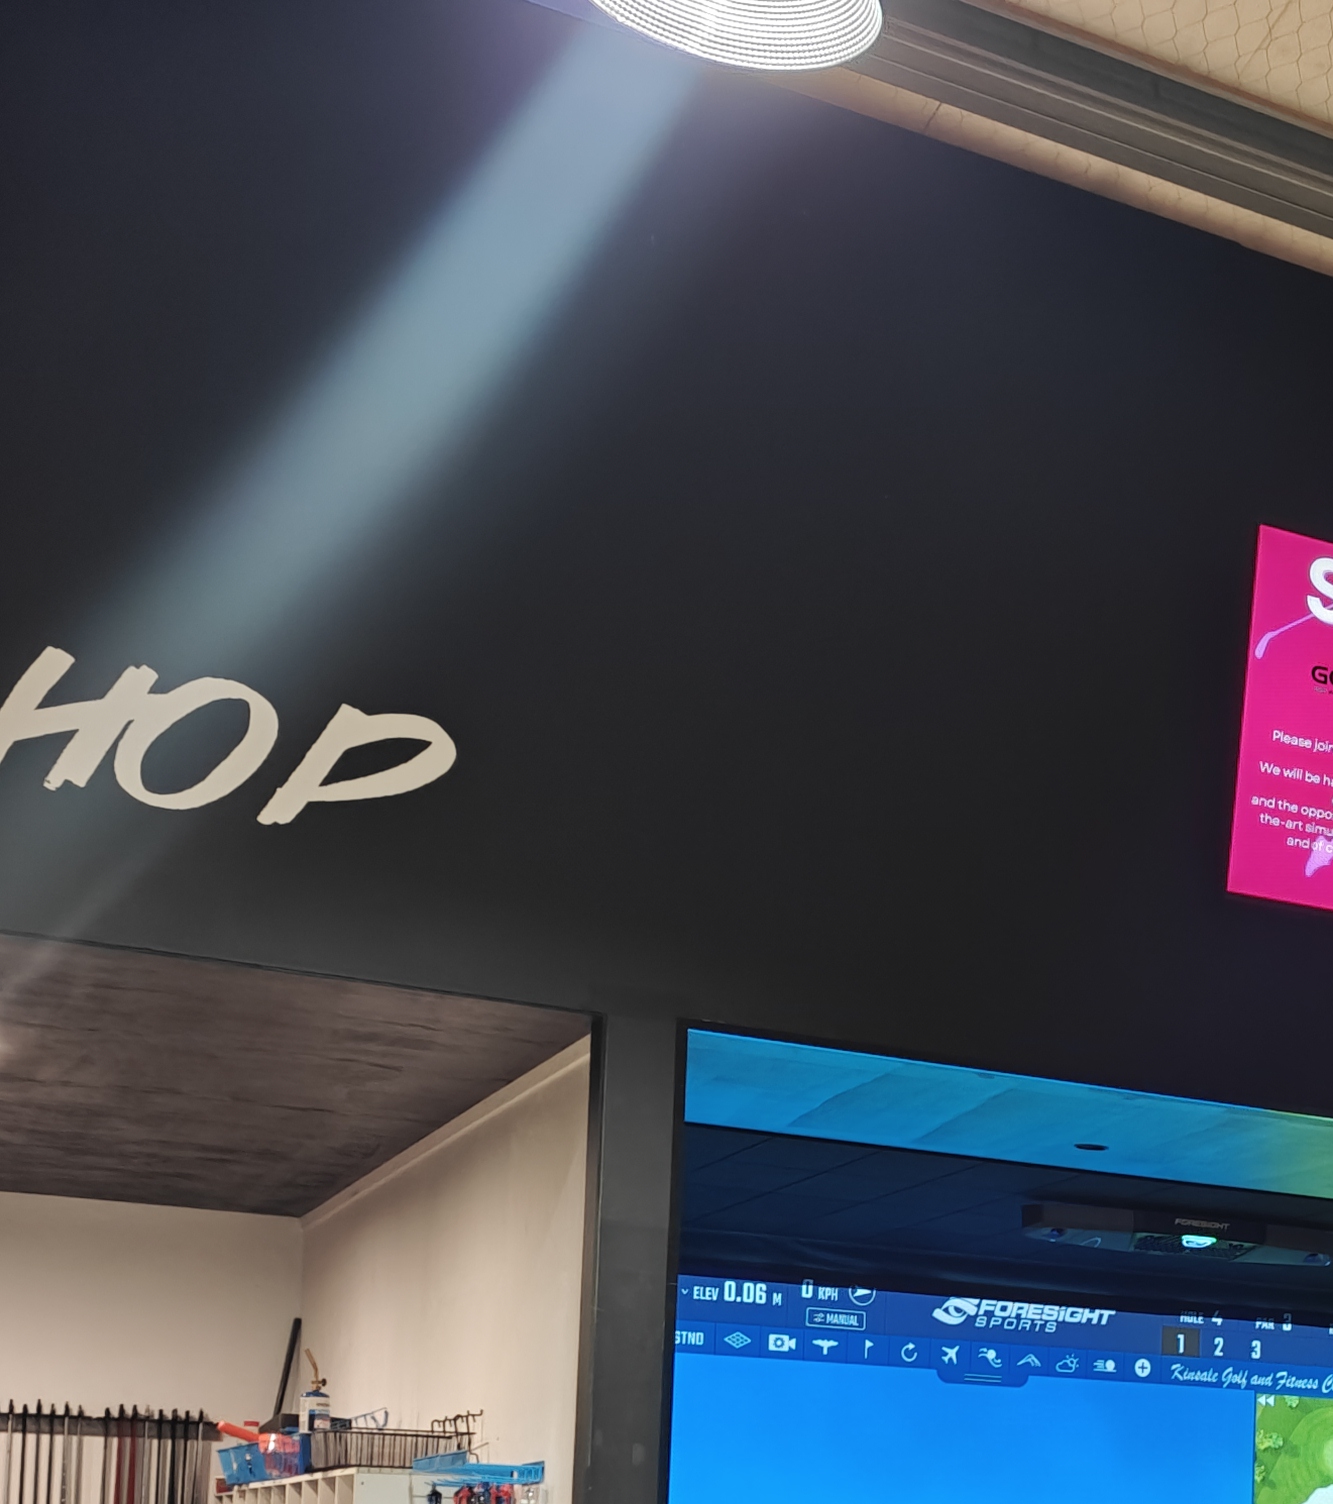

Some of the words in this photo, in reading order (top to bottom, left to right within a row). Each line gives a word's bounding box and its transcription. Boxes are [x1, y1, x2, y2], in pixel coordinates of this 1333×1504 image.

[693, 1285, 719, 1301] ELEV
[723, 1280, 767, 1304] 0.06
[772, 1292, 782, 1307] M
[818, 1287, 839, 1301] KPH
[826, 1313, 859, 1327] MANUAL
[974, 1316, 1057, 1333] SPORTS
[1176, 1334, 1185, 1354] 1
[1214, 1337, 1224, 1357] 2
[1251, 1340, 1261, 1359] 3
[1221, 1366, 1249, 1390] Golf
[1250, 1370, 1274, 1387] and
[1275, 1371, 1319, 1391] Fitness
